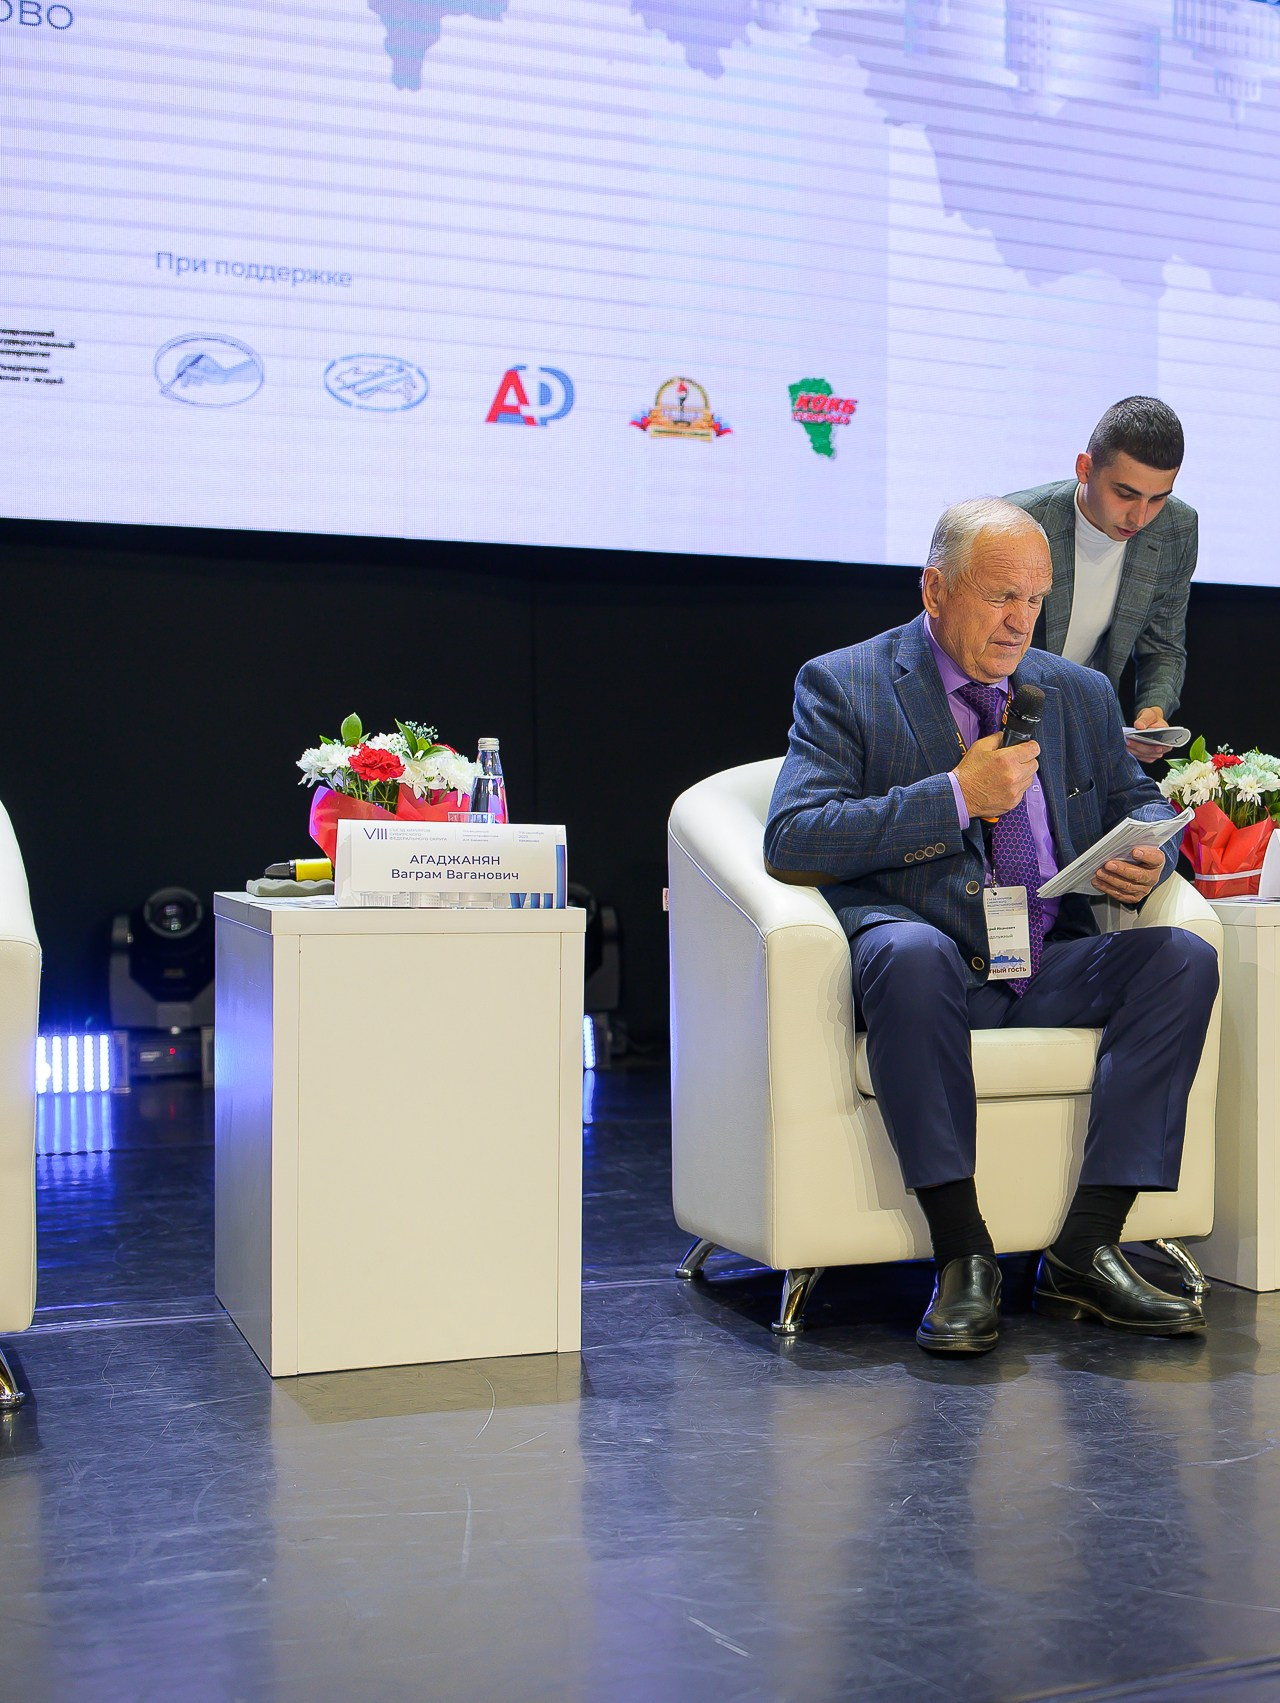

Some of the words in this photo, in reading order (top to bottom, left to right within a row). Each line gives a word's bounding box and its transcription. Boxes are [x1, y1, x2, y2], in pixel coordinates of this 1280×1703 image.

[155, 250, 207, 277] При
[215, 259, 352, 288] поддержке
[363, 827, 388, 840] VIII
[409, 854, 501, 866] АГАДЖАНЯН
[391, 868, 442, 881] Ваграм
[446, 869, 519, 881] Ваганович
